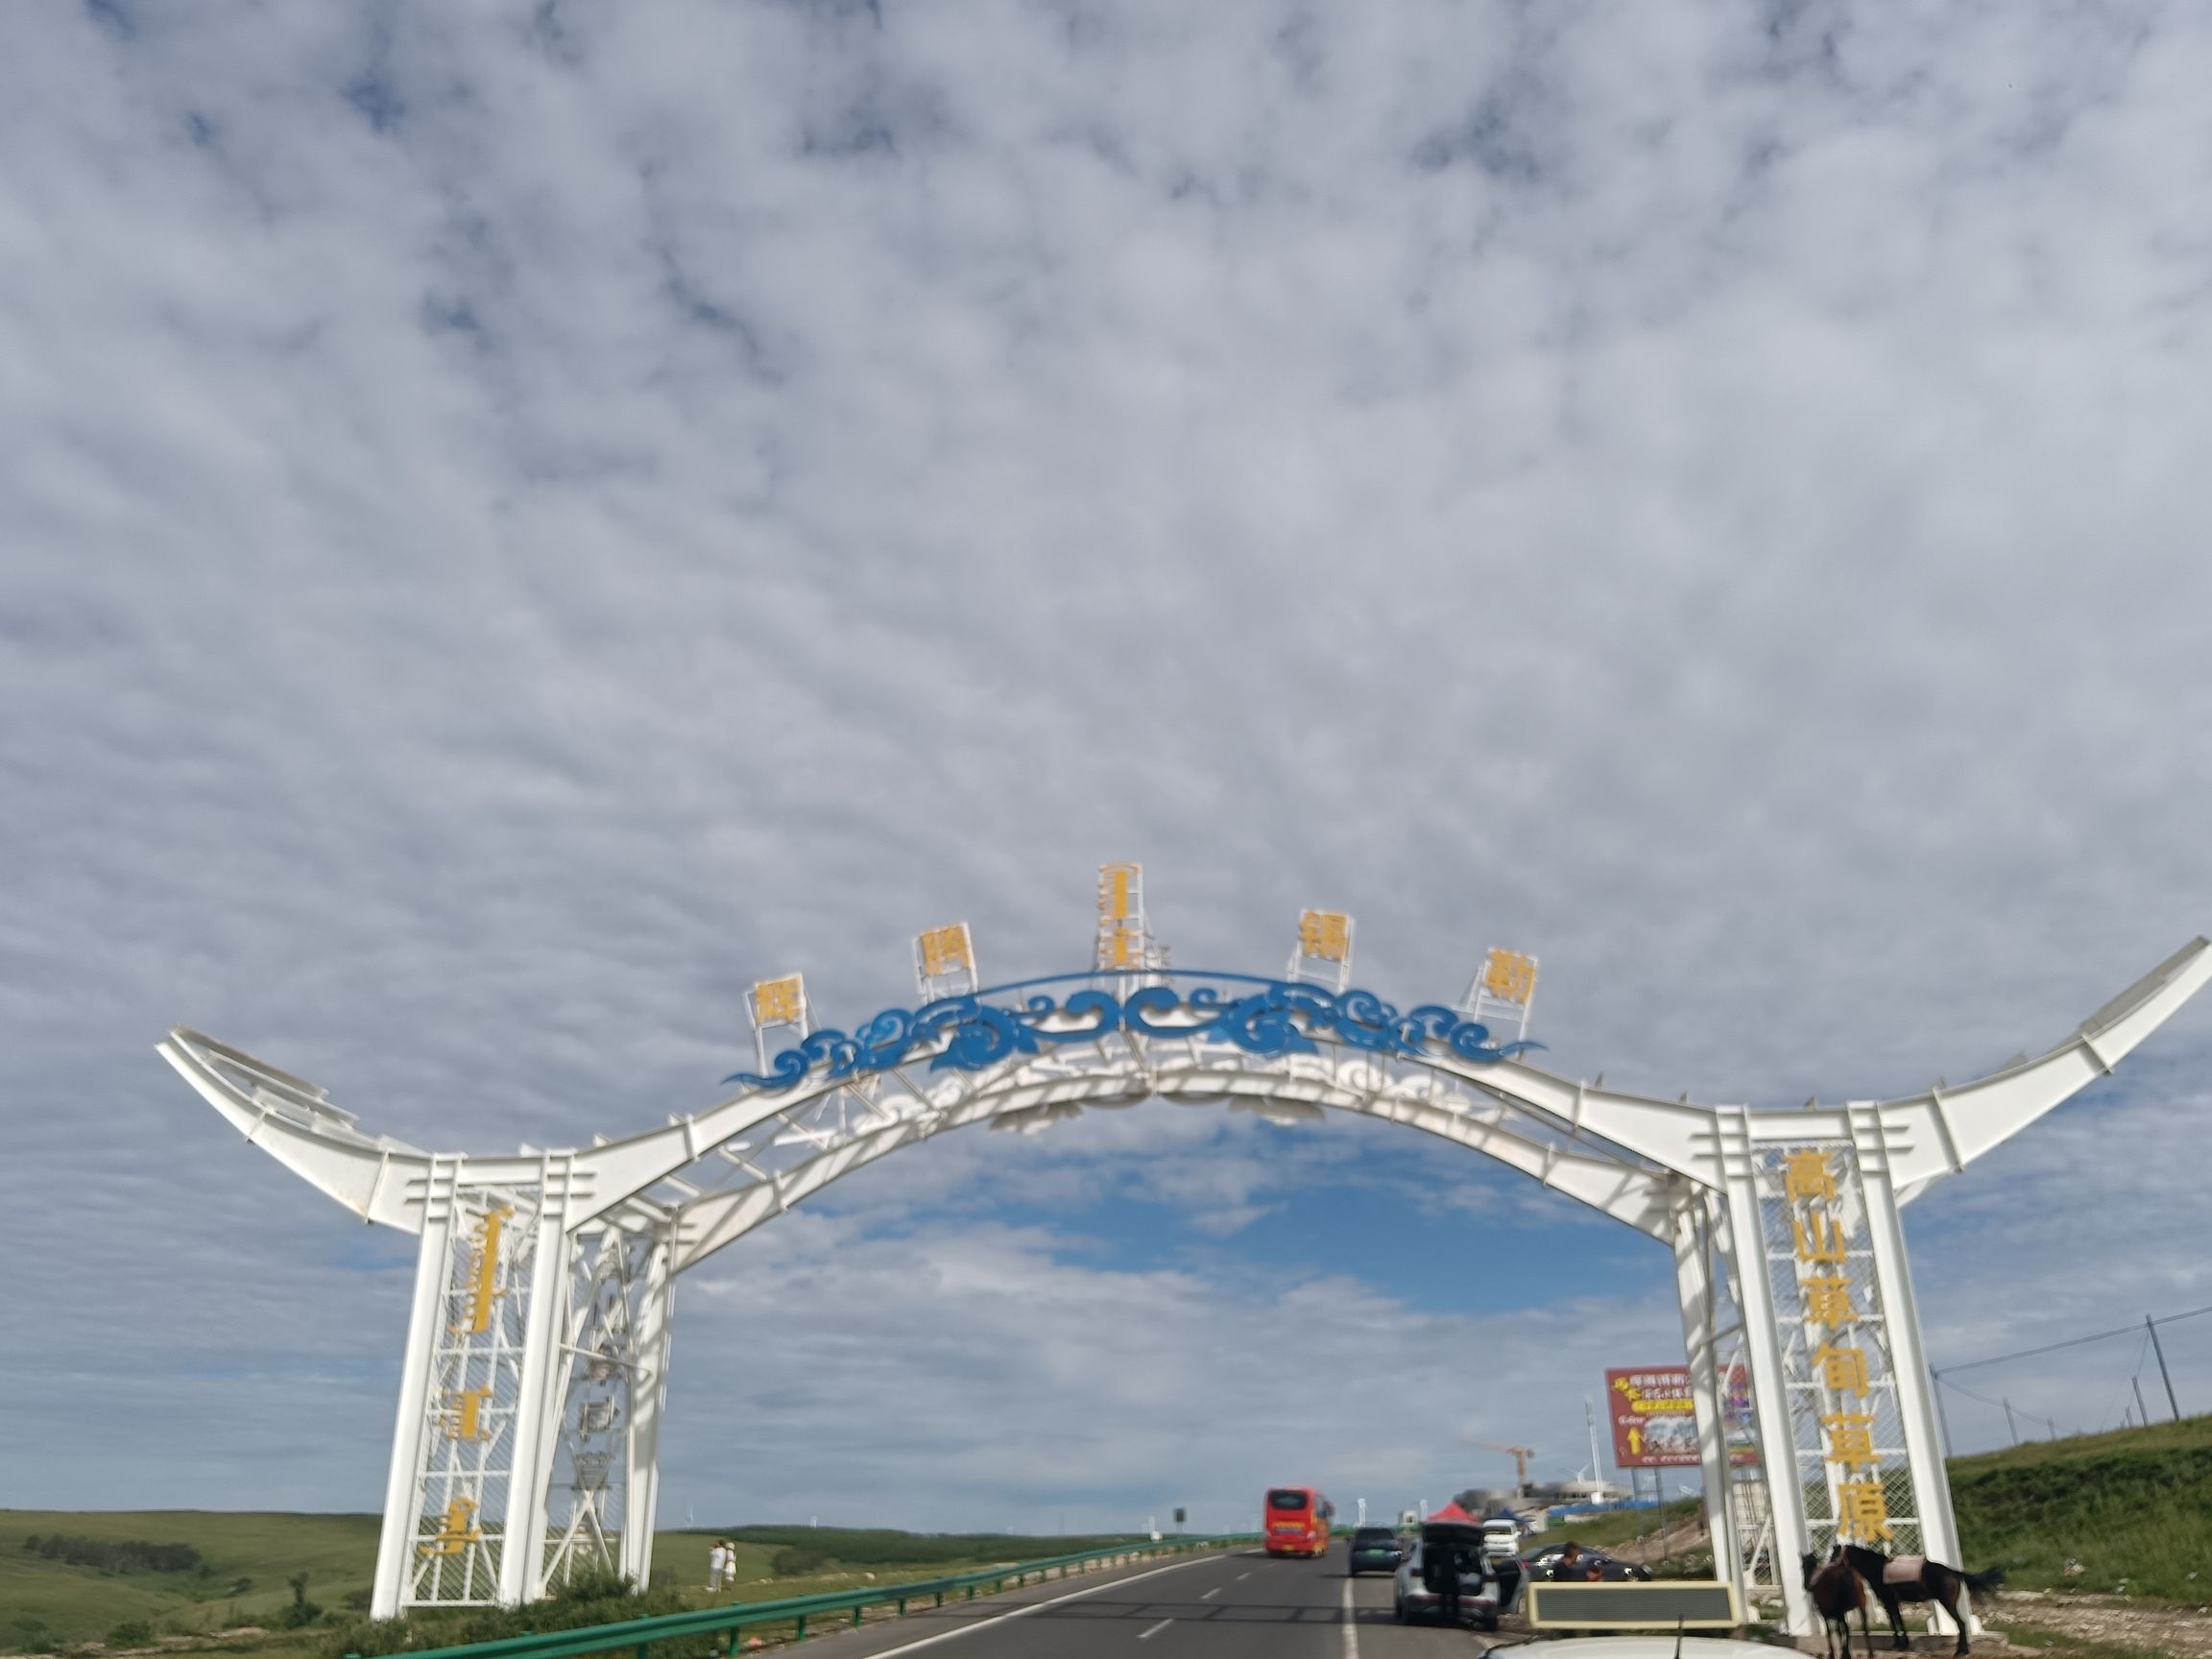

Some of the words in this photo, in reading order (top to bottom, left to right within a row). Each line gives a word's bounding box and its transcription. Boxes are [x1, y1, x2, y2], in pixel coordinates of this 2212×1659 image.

[1783, 1148, 1893, 1544] 高山草甸草原
